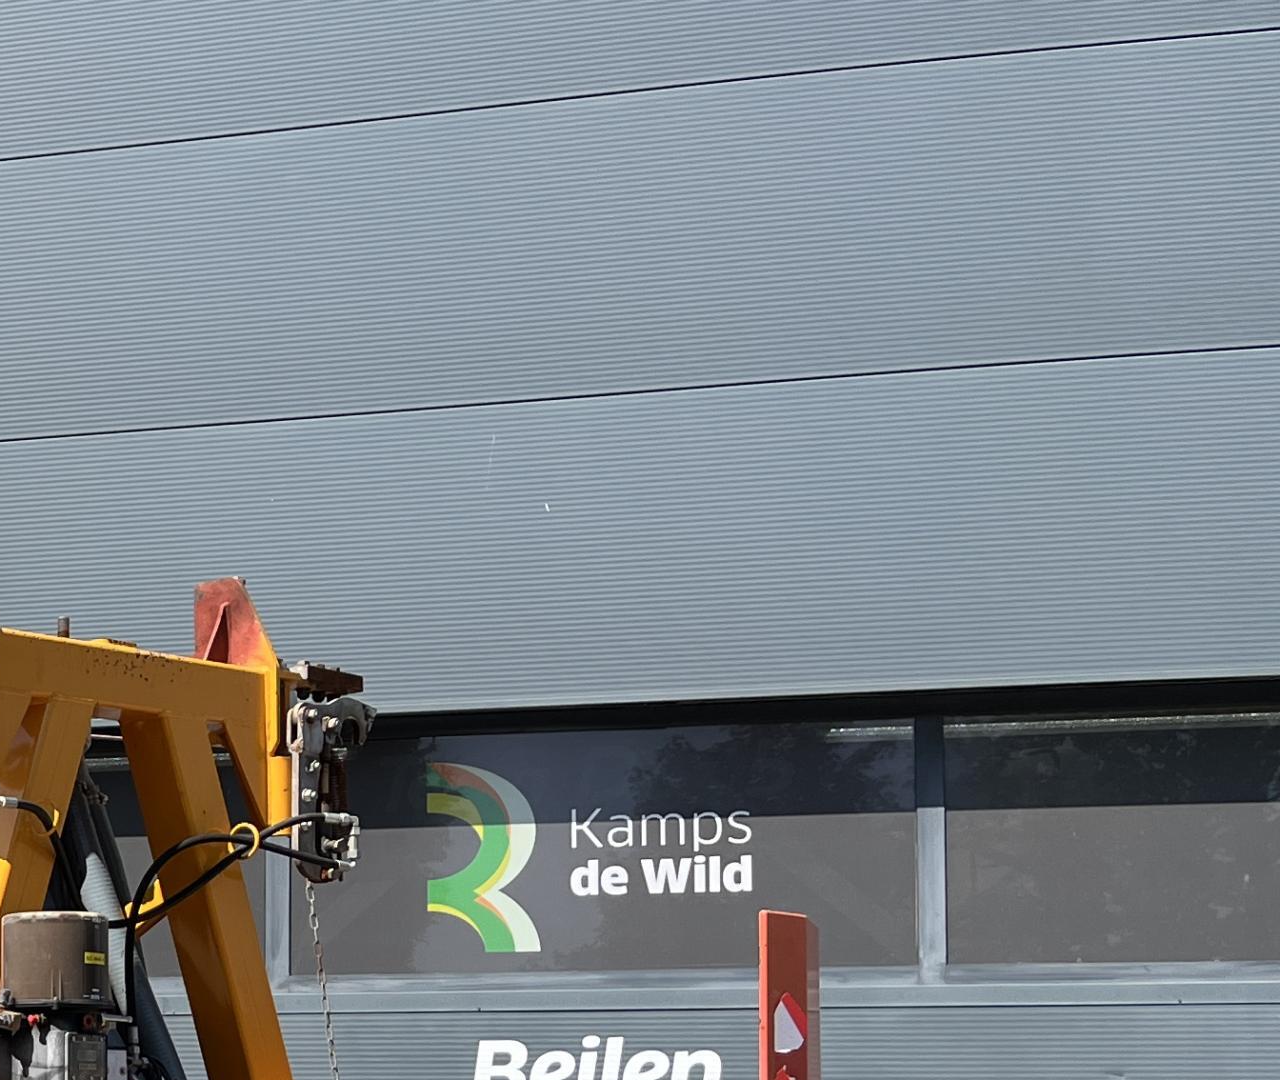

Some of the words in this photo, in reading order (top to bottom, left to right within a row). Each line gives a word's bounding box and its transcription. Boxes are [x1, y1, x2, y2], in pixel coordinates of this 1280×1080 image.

[570, 808, 752, 852] Kamps
[570, 859, 628, 896] de
[641, 855, 753, 894] Wild
